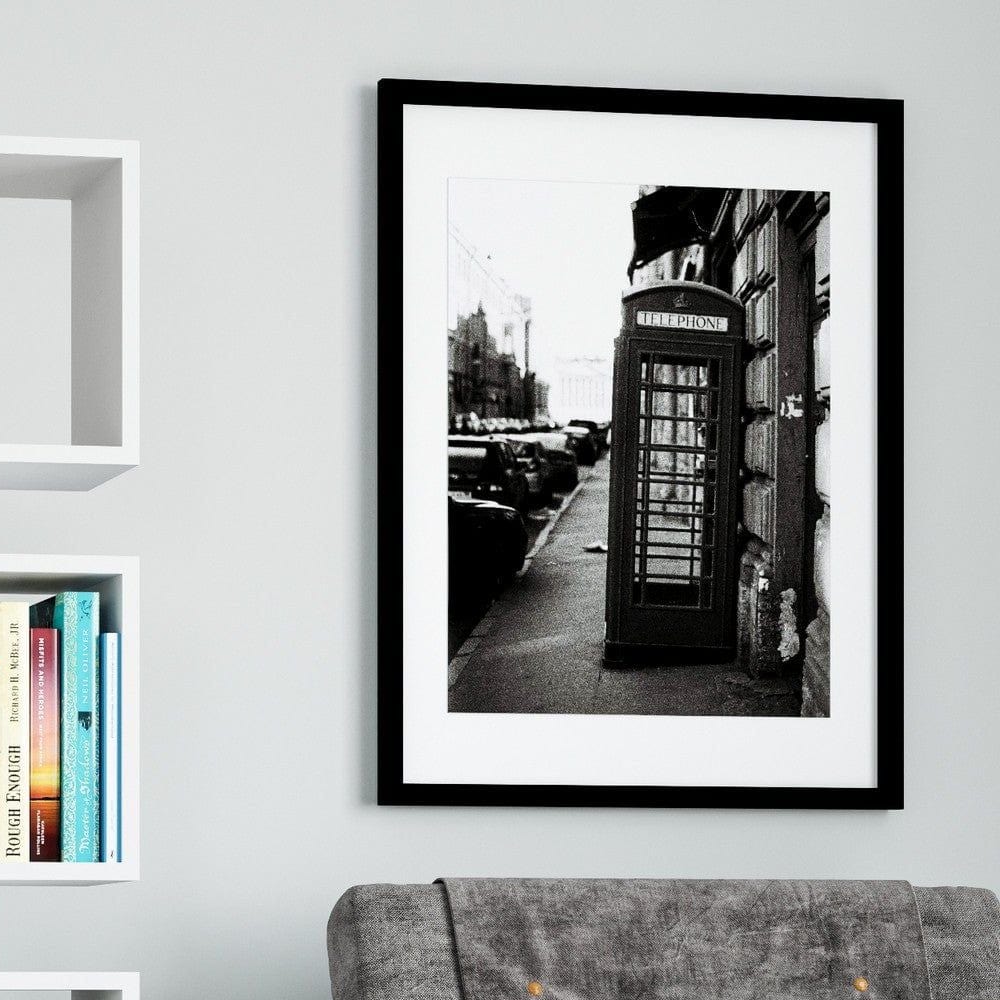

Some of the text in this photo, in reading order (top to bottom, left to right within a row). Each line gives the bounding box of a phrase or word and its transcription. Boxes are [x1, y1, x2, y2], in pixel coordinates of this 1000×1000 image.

[641, 312, 725, 331] TELEPHONE
[79, 738, 91, 795] Shadows
[5, 744, 21, 857] ROUGH ENOUGH
[79, 805, 91, 852] Master
